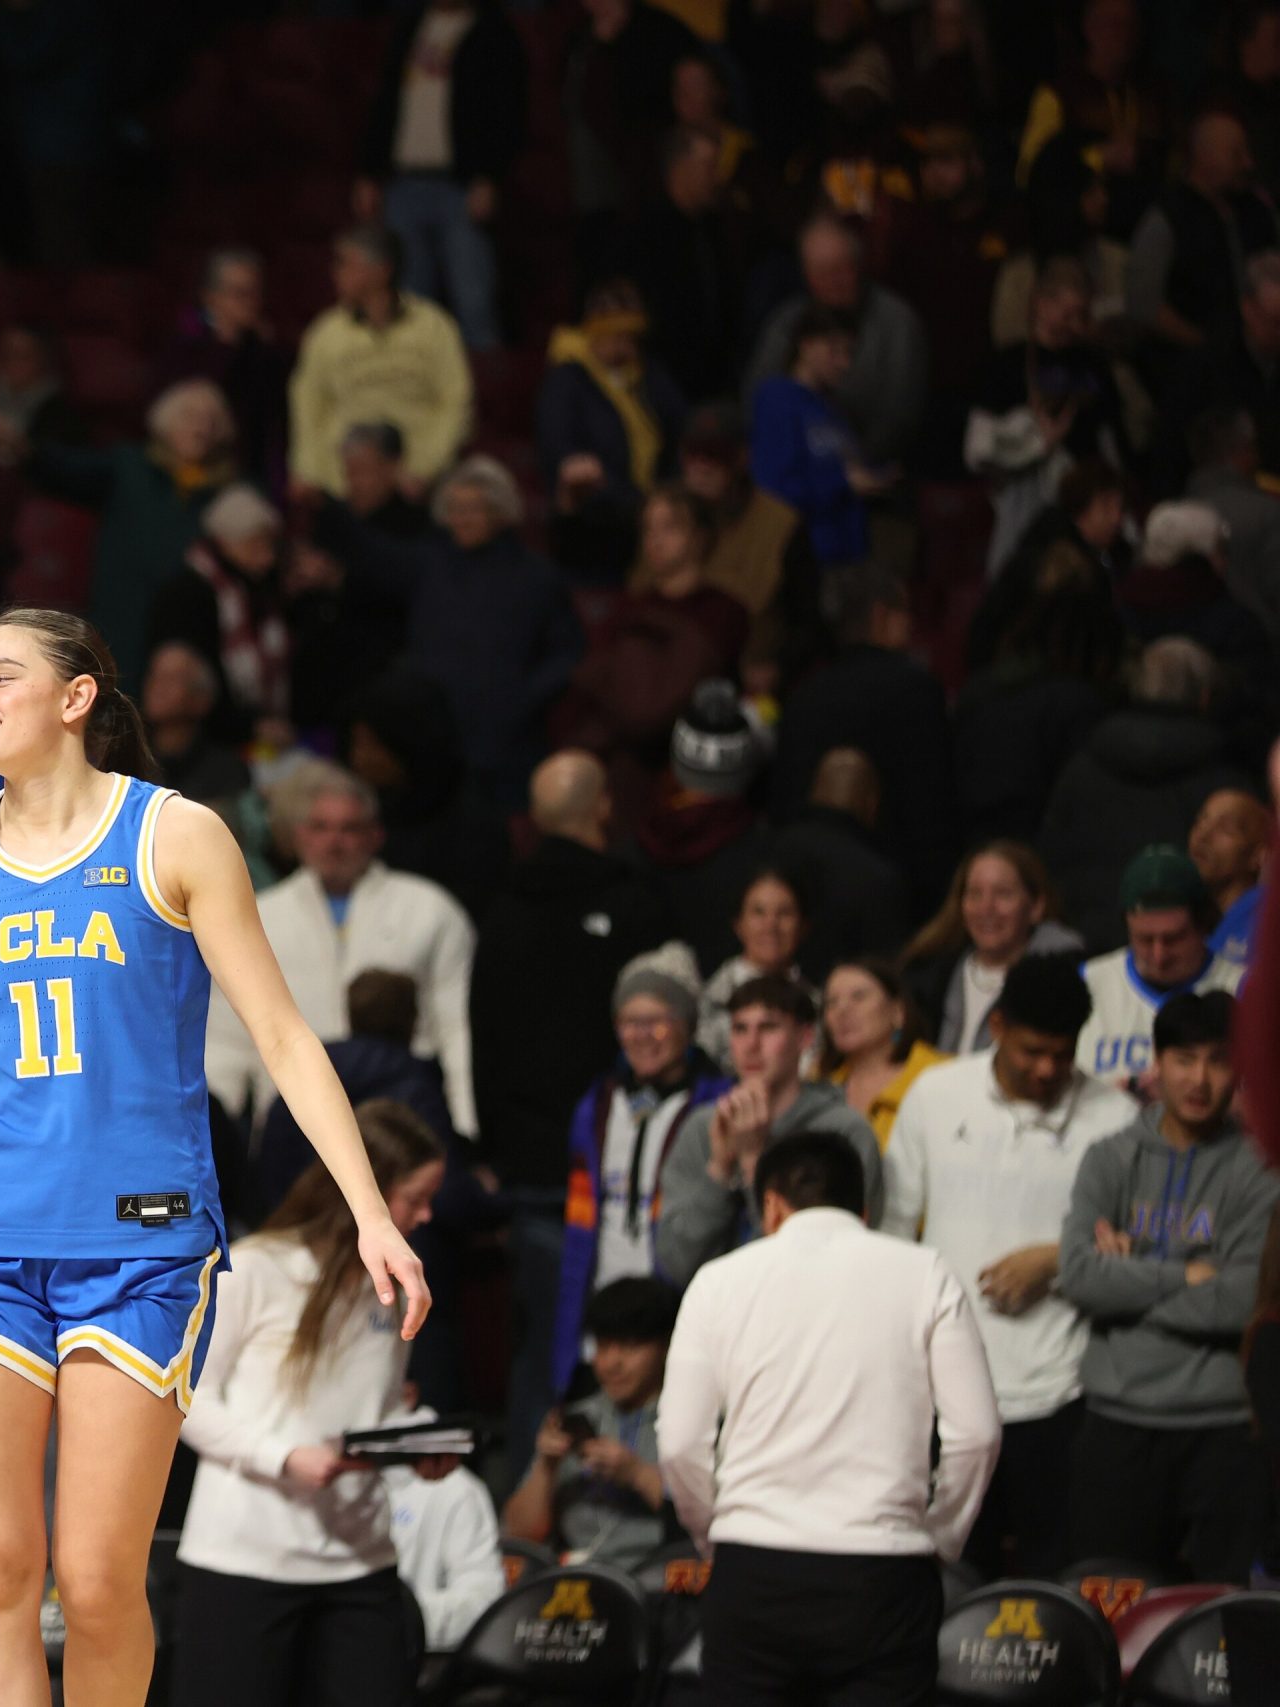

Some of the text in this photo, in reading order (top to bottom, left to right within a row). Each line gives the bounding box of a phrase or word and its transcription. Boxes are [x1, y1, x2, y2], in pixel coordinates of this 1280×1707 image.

[8, 978, 82, 1079] 11
[1094, 1034, 1151, 1073] UC
[172, 1199, 185, 1210] 44
[957, 1638, 1060, 1667] HEALTH
